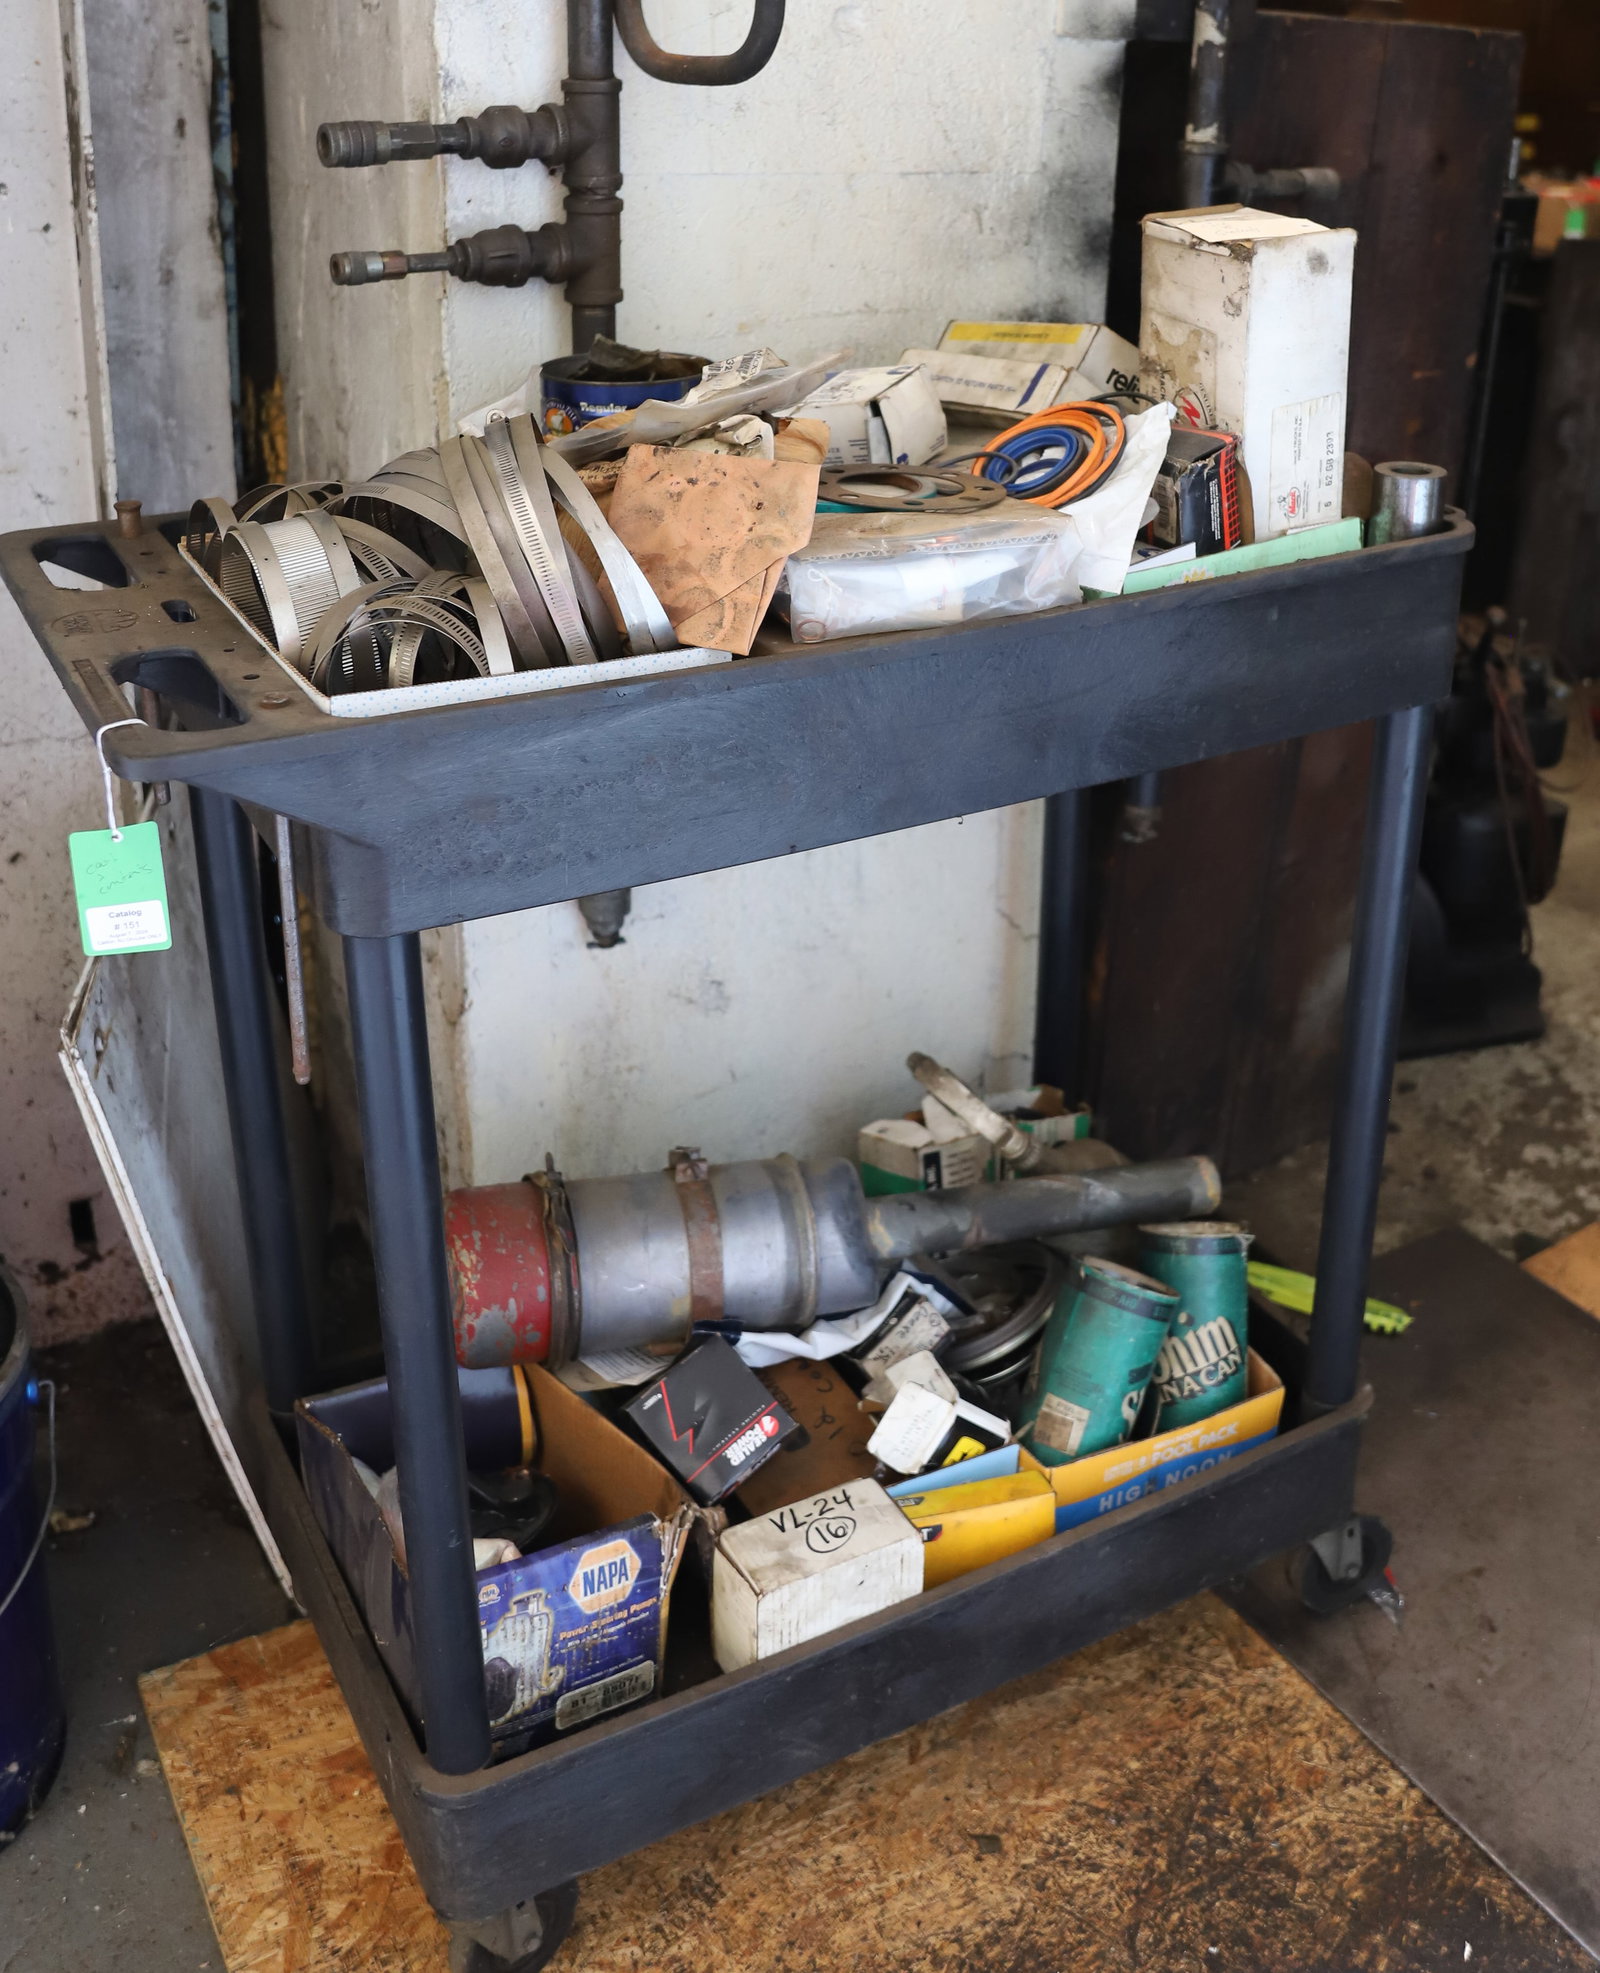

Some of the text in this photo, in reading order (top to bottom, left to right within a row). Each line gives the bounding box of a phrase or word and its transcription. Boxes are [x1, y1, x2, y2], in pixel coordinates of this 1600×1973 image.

[579, 401, 628, 414] Regular
[108, 909, 143, 919] Catalog
[123, 920, 140, 930] 151
[1200, 1351, 1242, 1387] CAN
[730, 1434, 769, 1467] SEALED
[1151, 1438, 1195, 1466] POOL
[1198, 1422, 1240, 1449] PACK
[582, 1556, 629, 1597] NAPA
